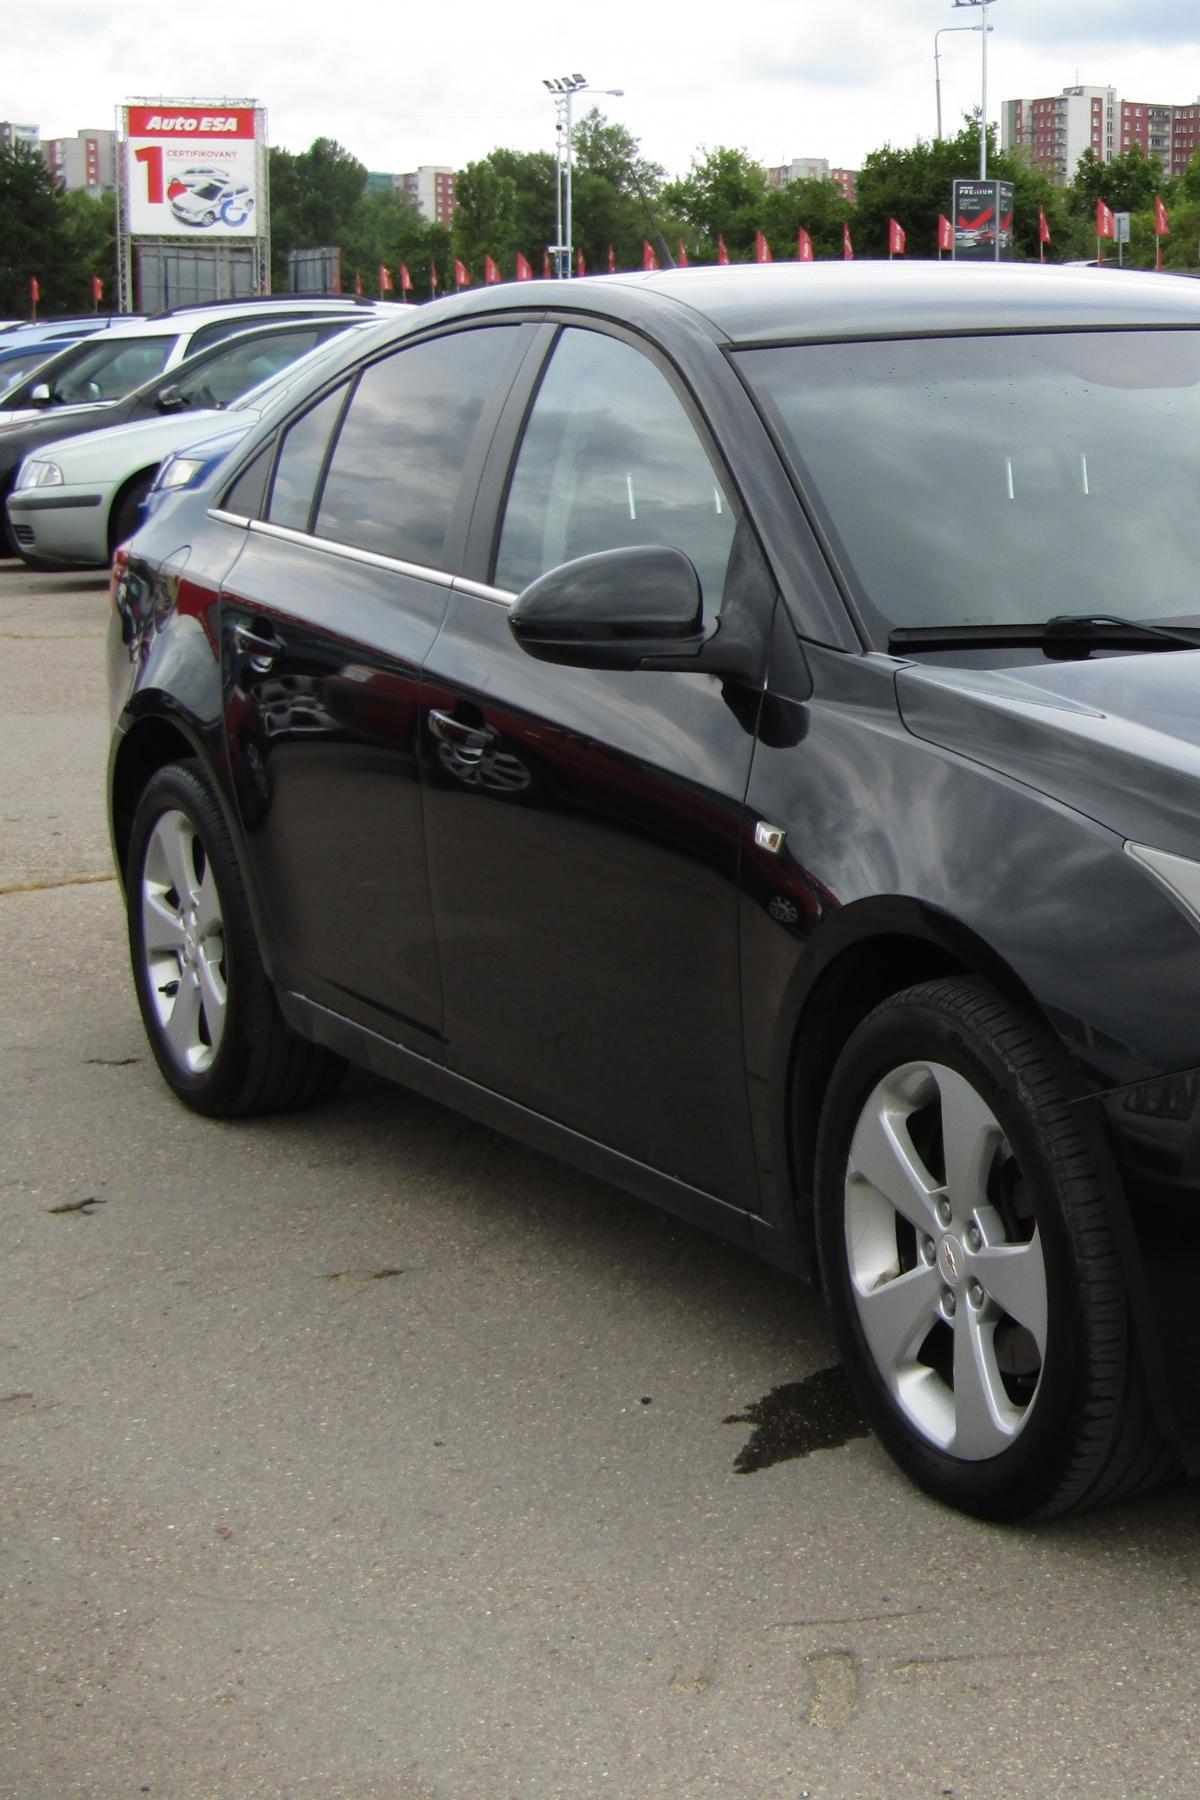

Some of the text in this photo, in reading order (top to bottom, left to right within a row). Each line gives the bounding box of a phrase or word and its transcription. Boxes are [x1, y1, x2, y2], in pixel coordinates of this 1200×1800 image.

[146, 116, 237, 132] Auto ESA
[134, 146, 164, 204] 1
